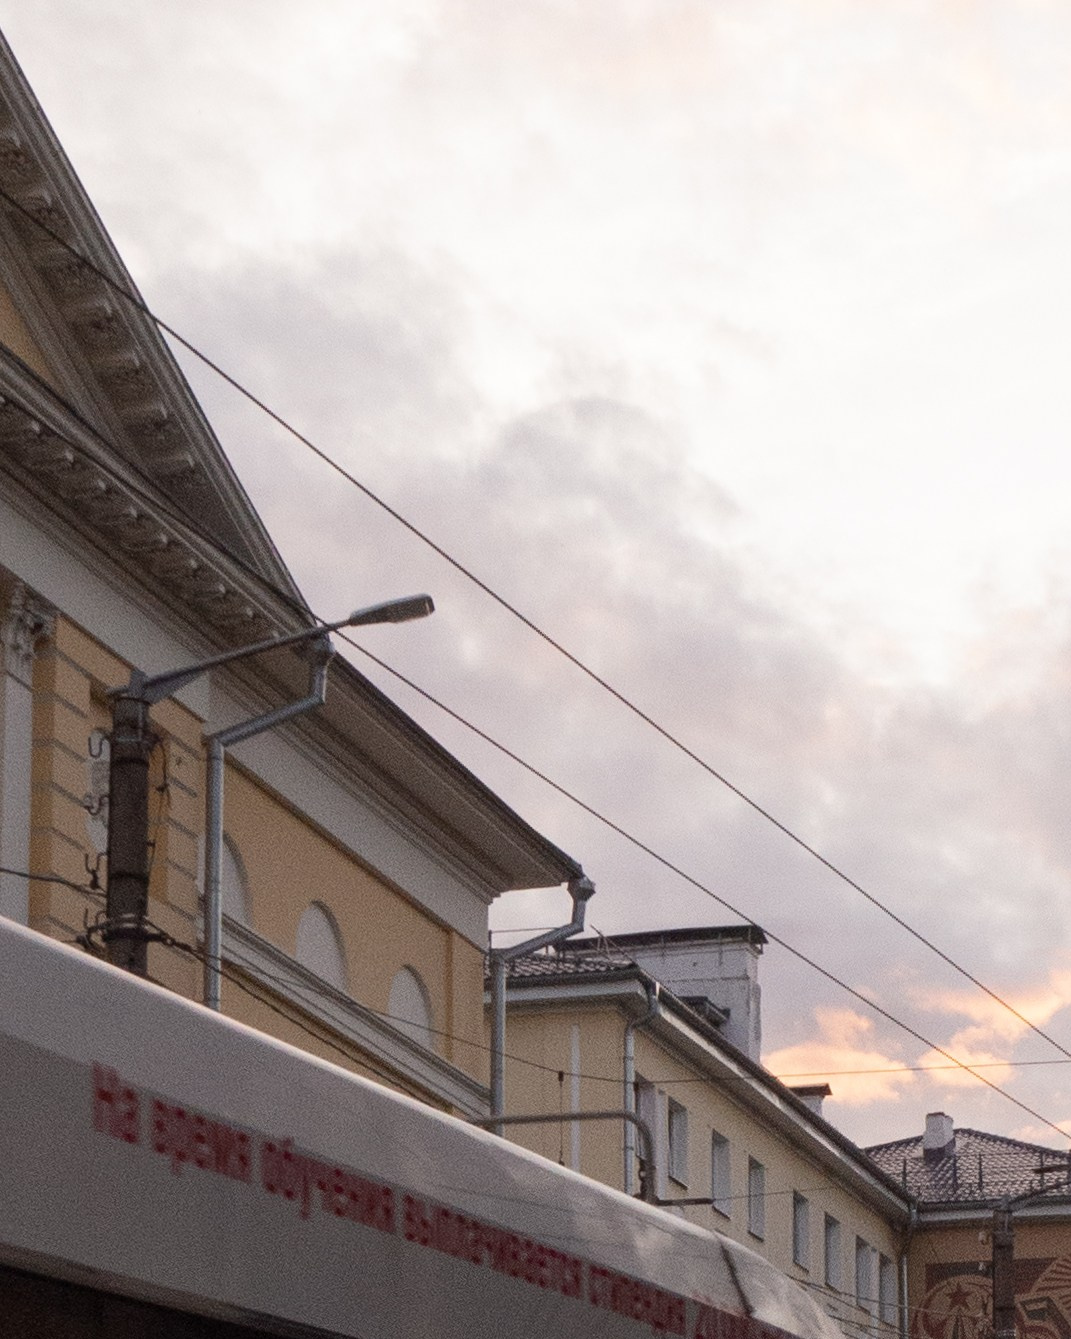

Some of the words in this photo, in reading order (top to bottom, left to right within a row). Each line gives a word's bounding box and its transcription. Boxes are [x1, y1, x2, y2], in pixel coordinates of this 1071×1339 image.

[92, 1062, 140, 1145] На
[151, 1098, 252, 1184] время
[260, 1137, 397, 1234] обучения
[402, 1193, 582, 1299] выплачивается
